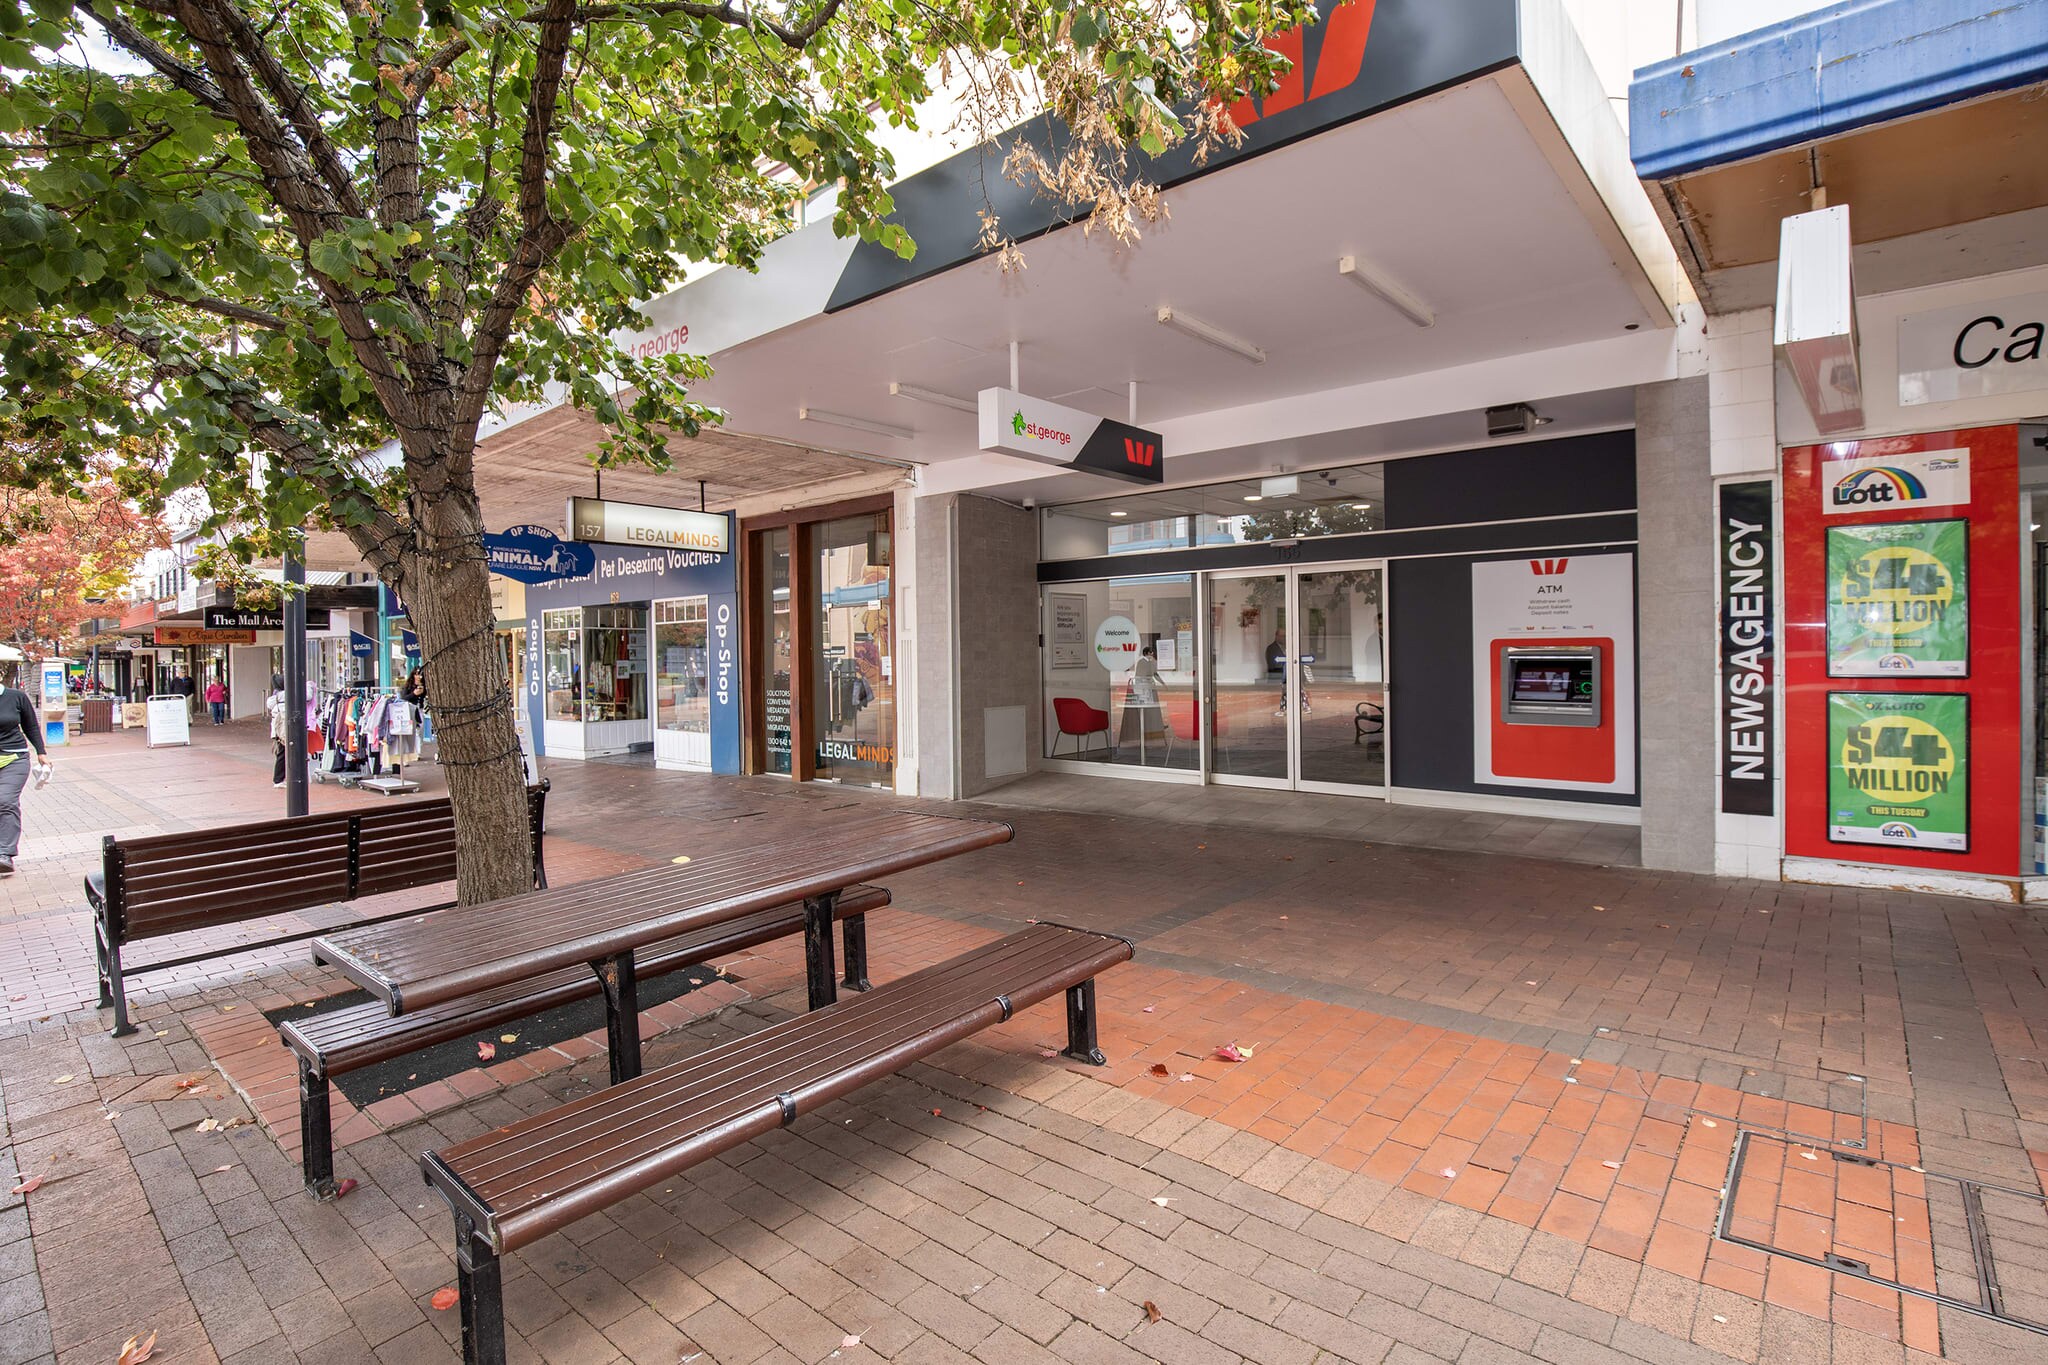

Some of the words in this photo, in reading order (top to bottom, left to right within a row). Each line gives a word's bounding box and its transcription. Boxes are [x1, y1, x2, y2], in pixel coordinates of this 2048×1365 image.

[1027, 423, 1071, 445] st.george
[1833, 483, 1893, 505] Lott
[510, 527, 524, 537] OP
[527, 525, 552, 539] SHOP
[580, 525, 600, 536] 157
[626, 526, 720, 548] LEGALMINDS
[600, 559, 615, 578] Pet
[617, 552, 664, 576] Desexing
[1537, 585, 1563, 594] ATM
[213, 614, 236, 626] The
[238, 614, 260, 626] Mall
[262, 615, 284, 626] Arc
[1846, 598, 1946, 624] MILLION
[530, 618, 539, 696] Op-Shop
[715, 604, 731, 705] Op-Shop
[1729, 518, 1764, 780] NEWSAGENCY
[1847, 725, 1947, 767] $4
[1848, 768, 1948, 794] MILLION
[1870, 806, 1890, 815] THIS
[1891, 806, 1926, 818] TUESDAY
[1882, 828, 1904, 838] Lott
